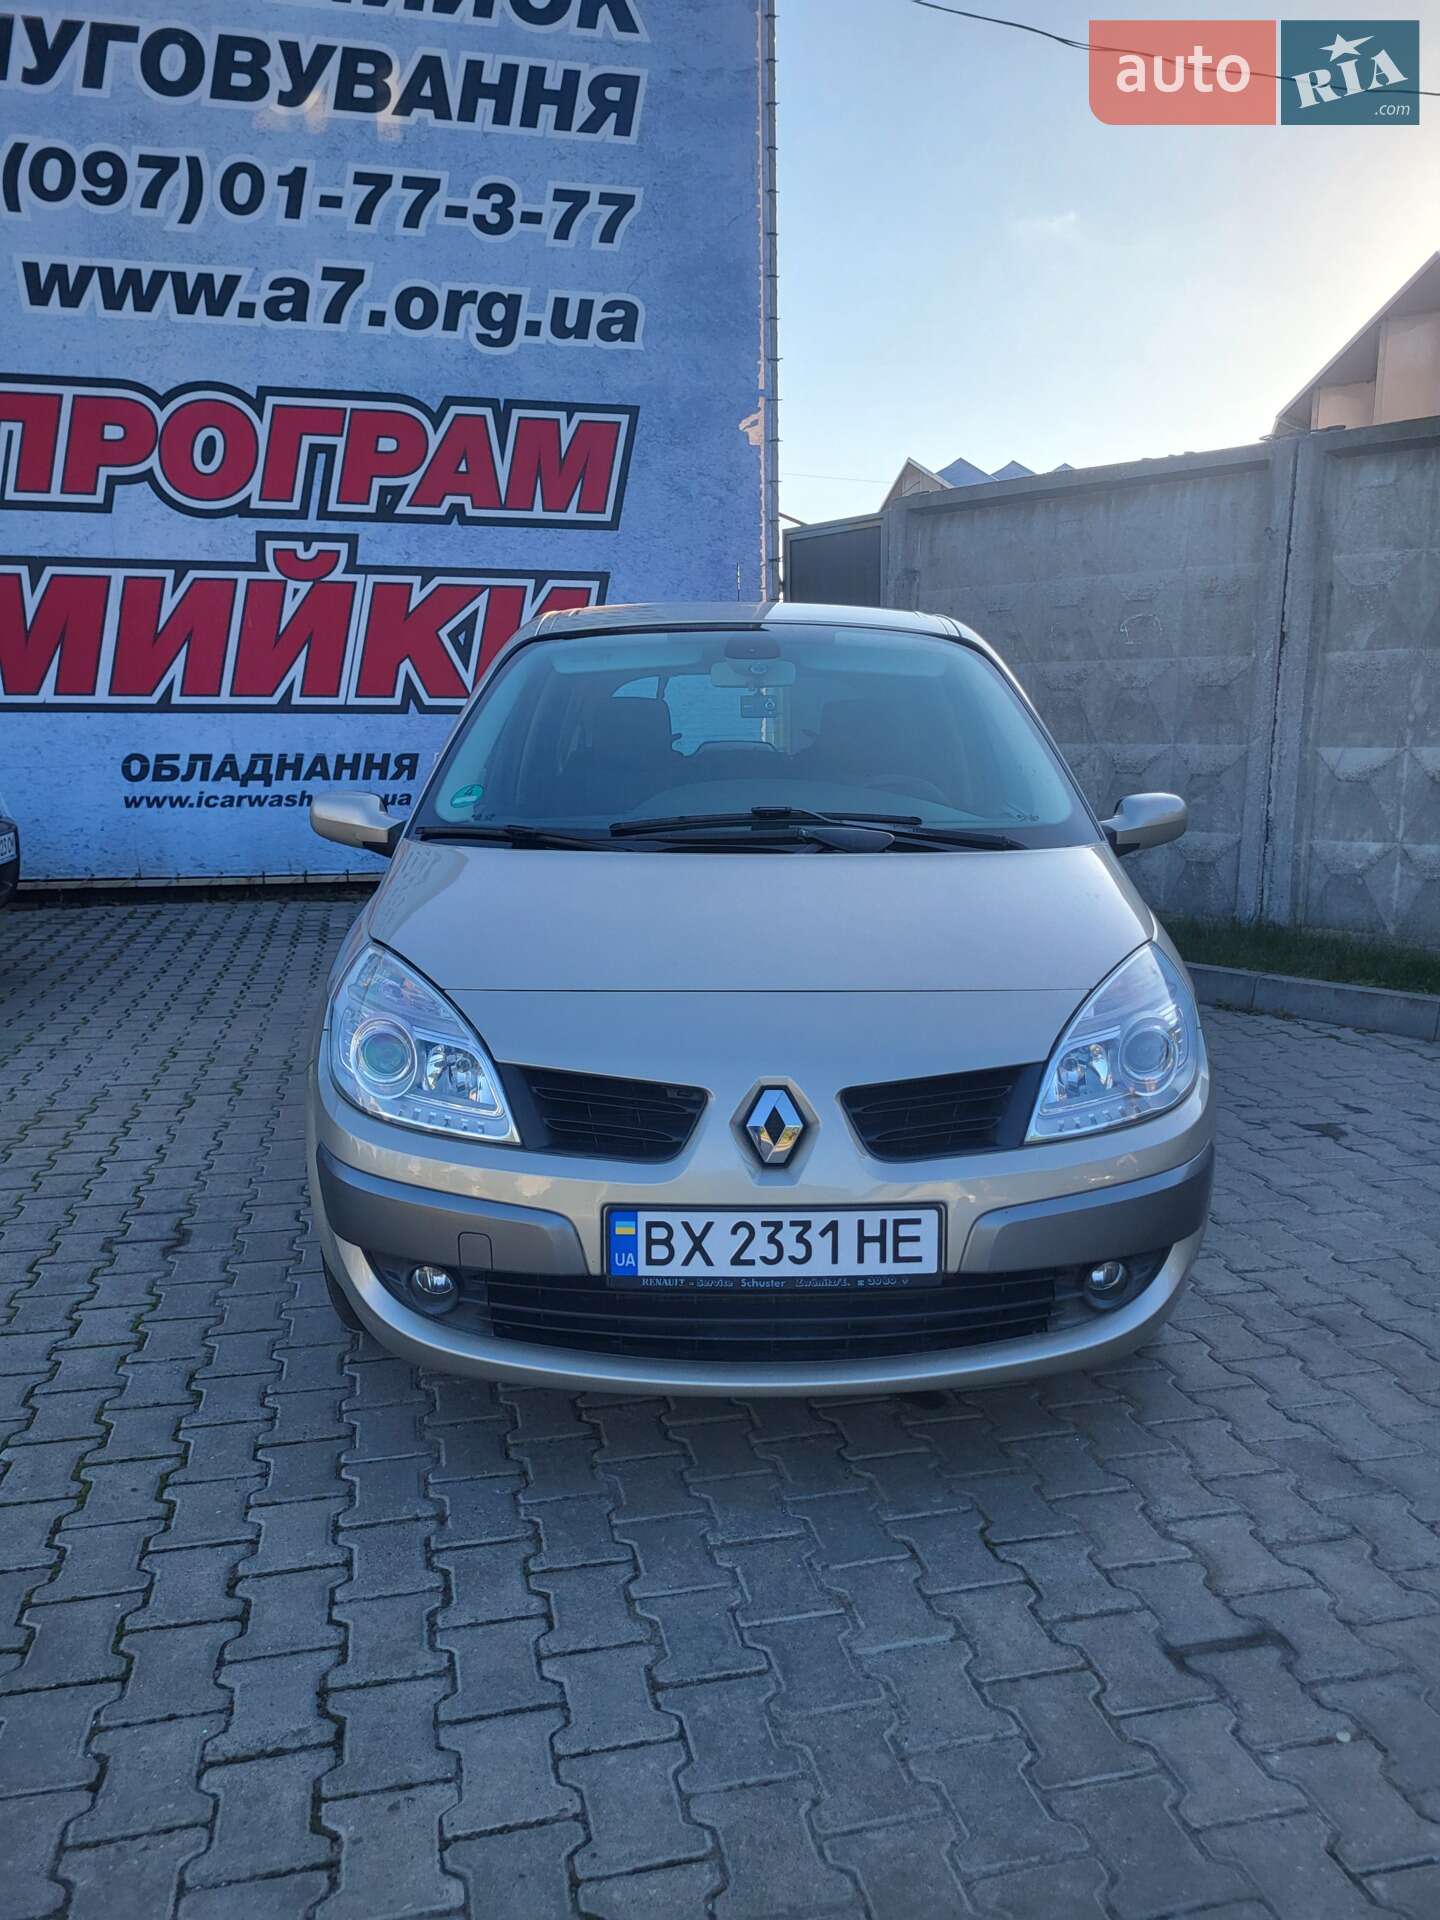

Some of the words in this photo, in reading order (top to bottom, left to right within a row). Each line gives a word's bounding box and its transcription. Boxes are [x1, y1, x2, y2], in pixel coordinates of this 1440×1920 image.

[0, 14, 641, 137] УГОВУВАННЯ
[22, 261, 638, 348] www.a7.org.ua
[0, 384, 630, 520] ПРОГРАМ
[121, 752, 420, 787] ОБЛАДНАННЯ
[615, 1253, 636, 1267] UA
[645, 1220, 714, 1267] BX
[730, 1220, 839, 1267] 2331
[857, 1218, 923, 1264] HE
[740, 1278, 786, 1288] Schuster
